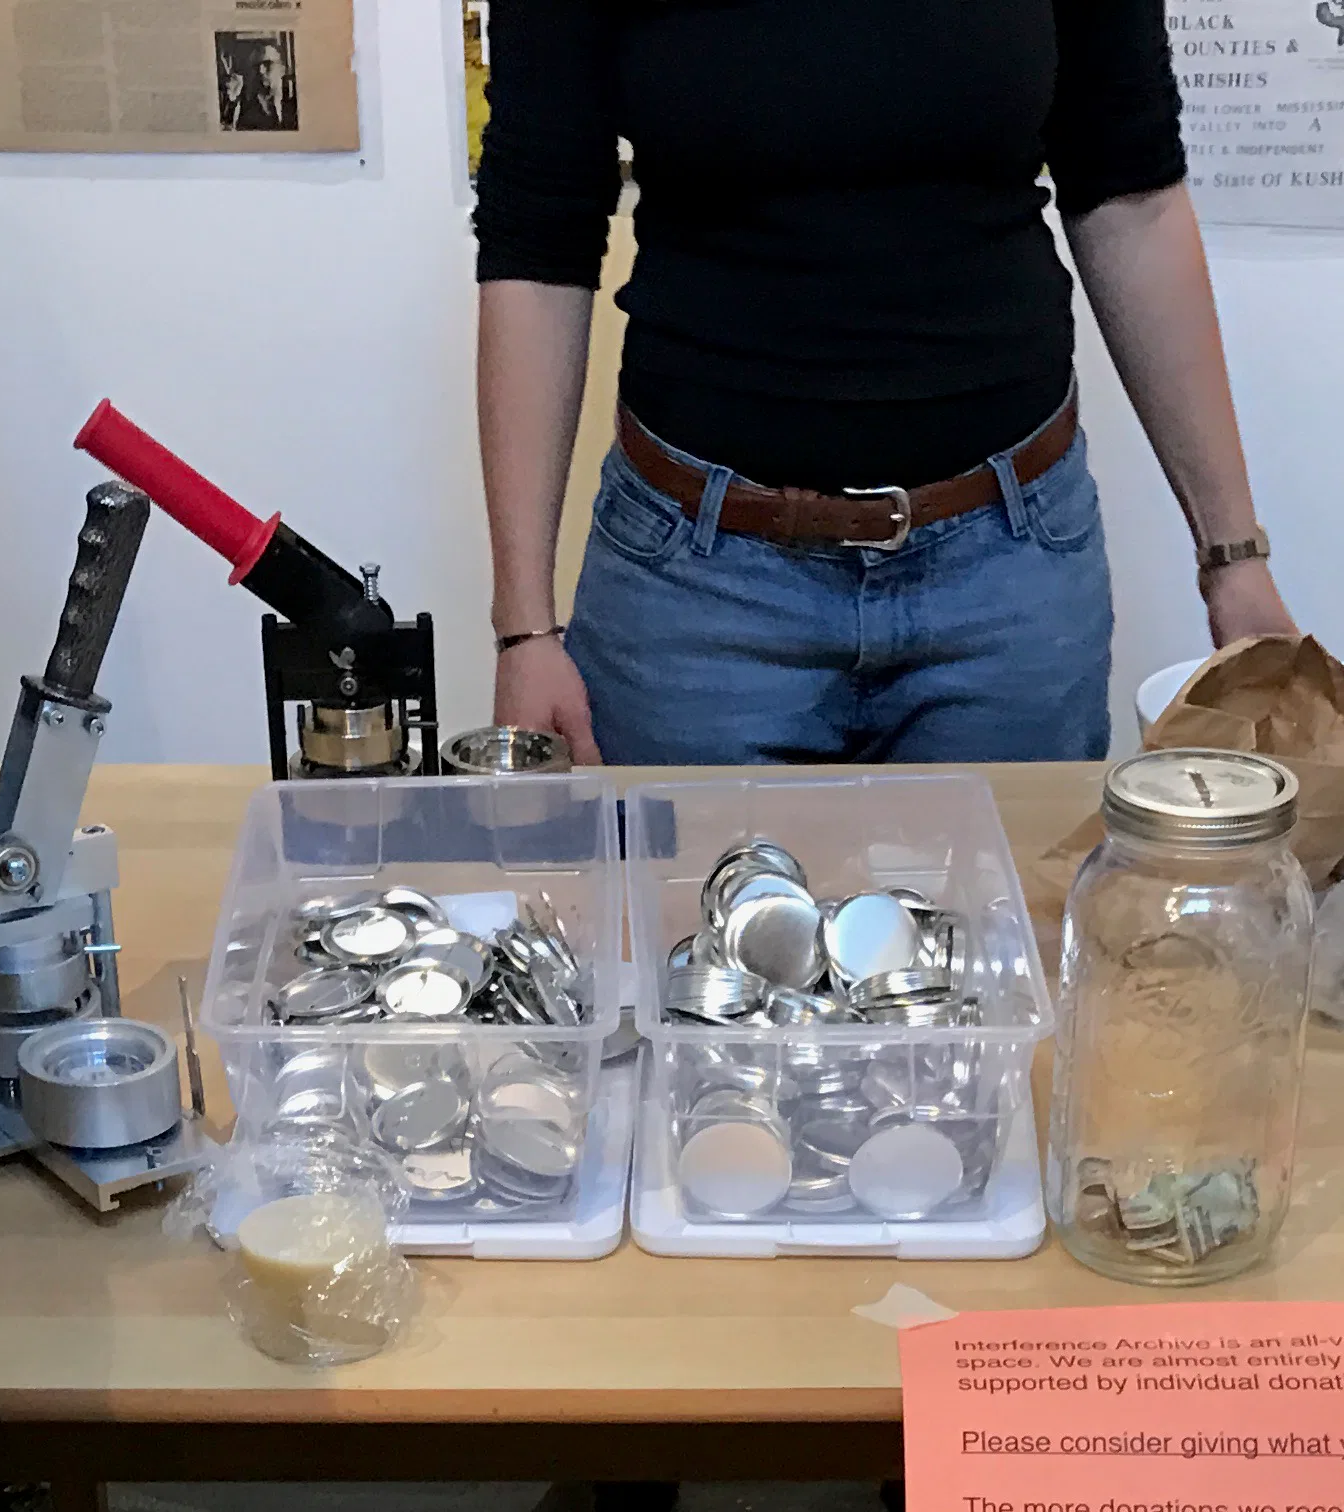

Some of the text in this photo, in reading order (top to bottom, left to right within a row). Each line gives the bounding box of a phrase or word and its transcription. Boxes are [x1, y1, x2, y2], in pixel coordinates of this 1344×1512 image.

[1168, 14, 1234, 31] BLACK
[1308, 117, 1322, 132] A
[1290, 170, 1344, 187] KUSH
[954, 1339, 1108, 1351] Interference
[1115, 1337, 1211, 1351] Archive
[1219, 1336, 1241, 1349] is
[1249, 1337, 1281, 1349] an
[955, 1352, 1342, 1371] space. We are almost entirely
[958, 1373, 1088, 1395] supported
[1096, 1373, 1129, 1395] by
[1136, 1373, 1260, 1391] individual
[961, 1430, 1051, 1452] Please
[1059, 1431, 1173, 1453] consider
[1180, 1431, 1259, 1459] giving
[1267, 1432, 1331, 1455] what
